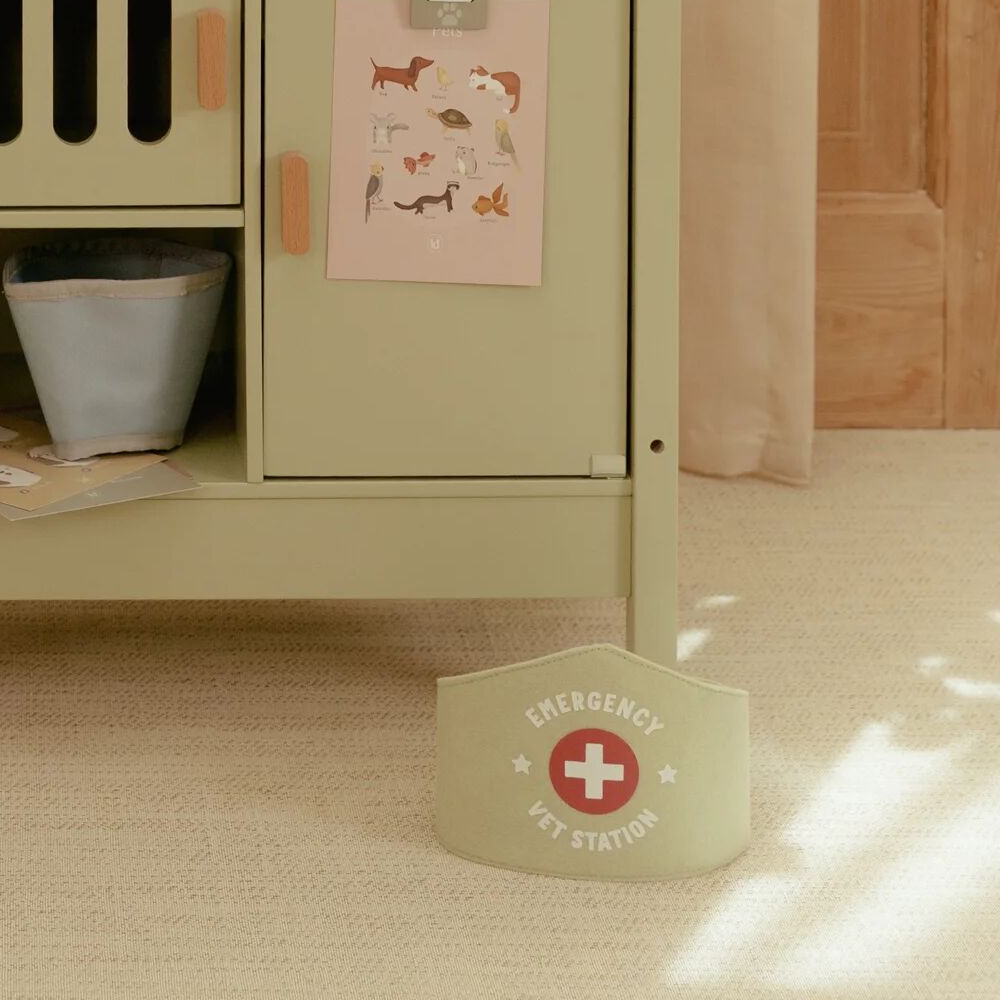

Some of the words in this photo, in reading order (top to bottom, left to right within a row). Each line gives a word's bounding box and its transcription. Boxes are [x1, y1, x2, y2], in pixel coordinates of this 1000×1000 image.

[525, 691, 664, 736] EMERGENCY
[528, 800, 567, 840] VET
[571, 808, 659, 852] STATION
